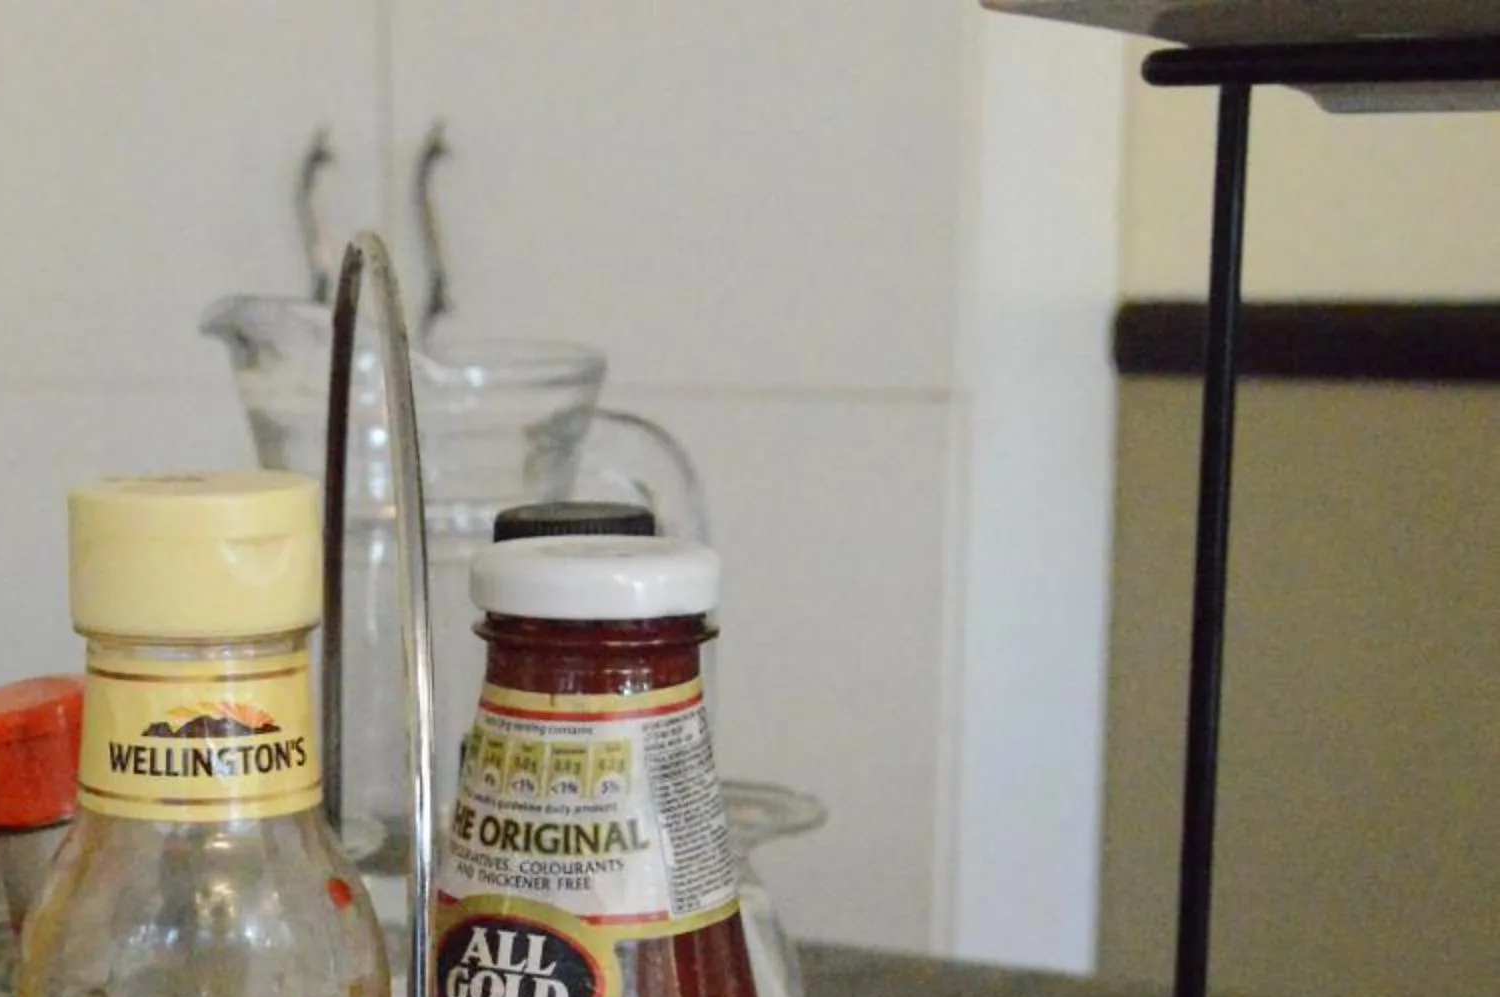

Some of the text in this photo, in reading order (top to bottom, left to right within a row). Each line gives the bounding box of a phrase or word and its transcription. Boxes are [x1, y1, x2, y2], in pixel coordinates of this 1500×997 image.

[109, 737, 307, 777] WELLINGTON'S
[479, 815, 650, 855] ORIGINAL
[519, 859, 625, 876] COLOURANTS
[460, 926, 557, 977] ALL
